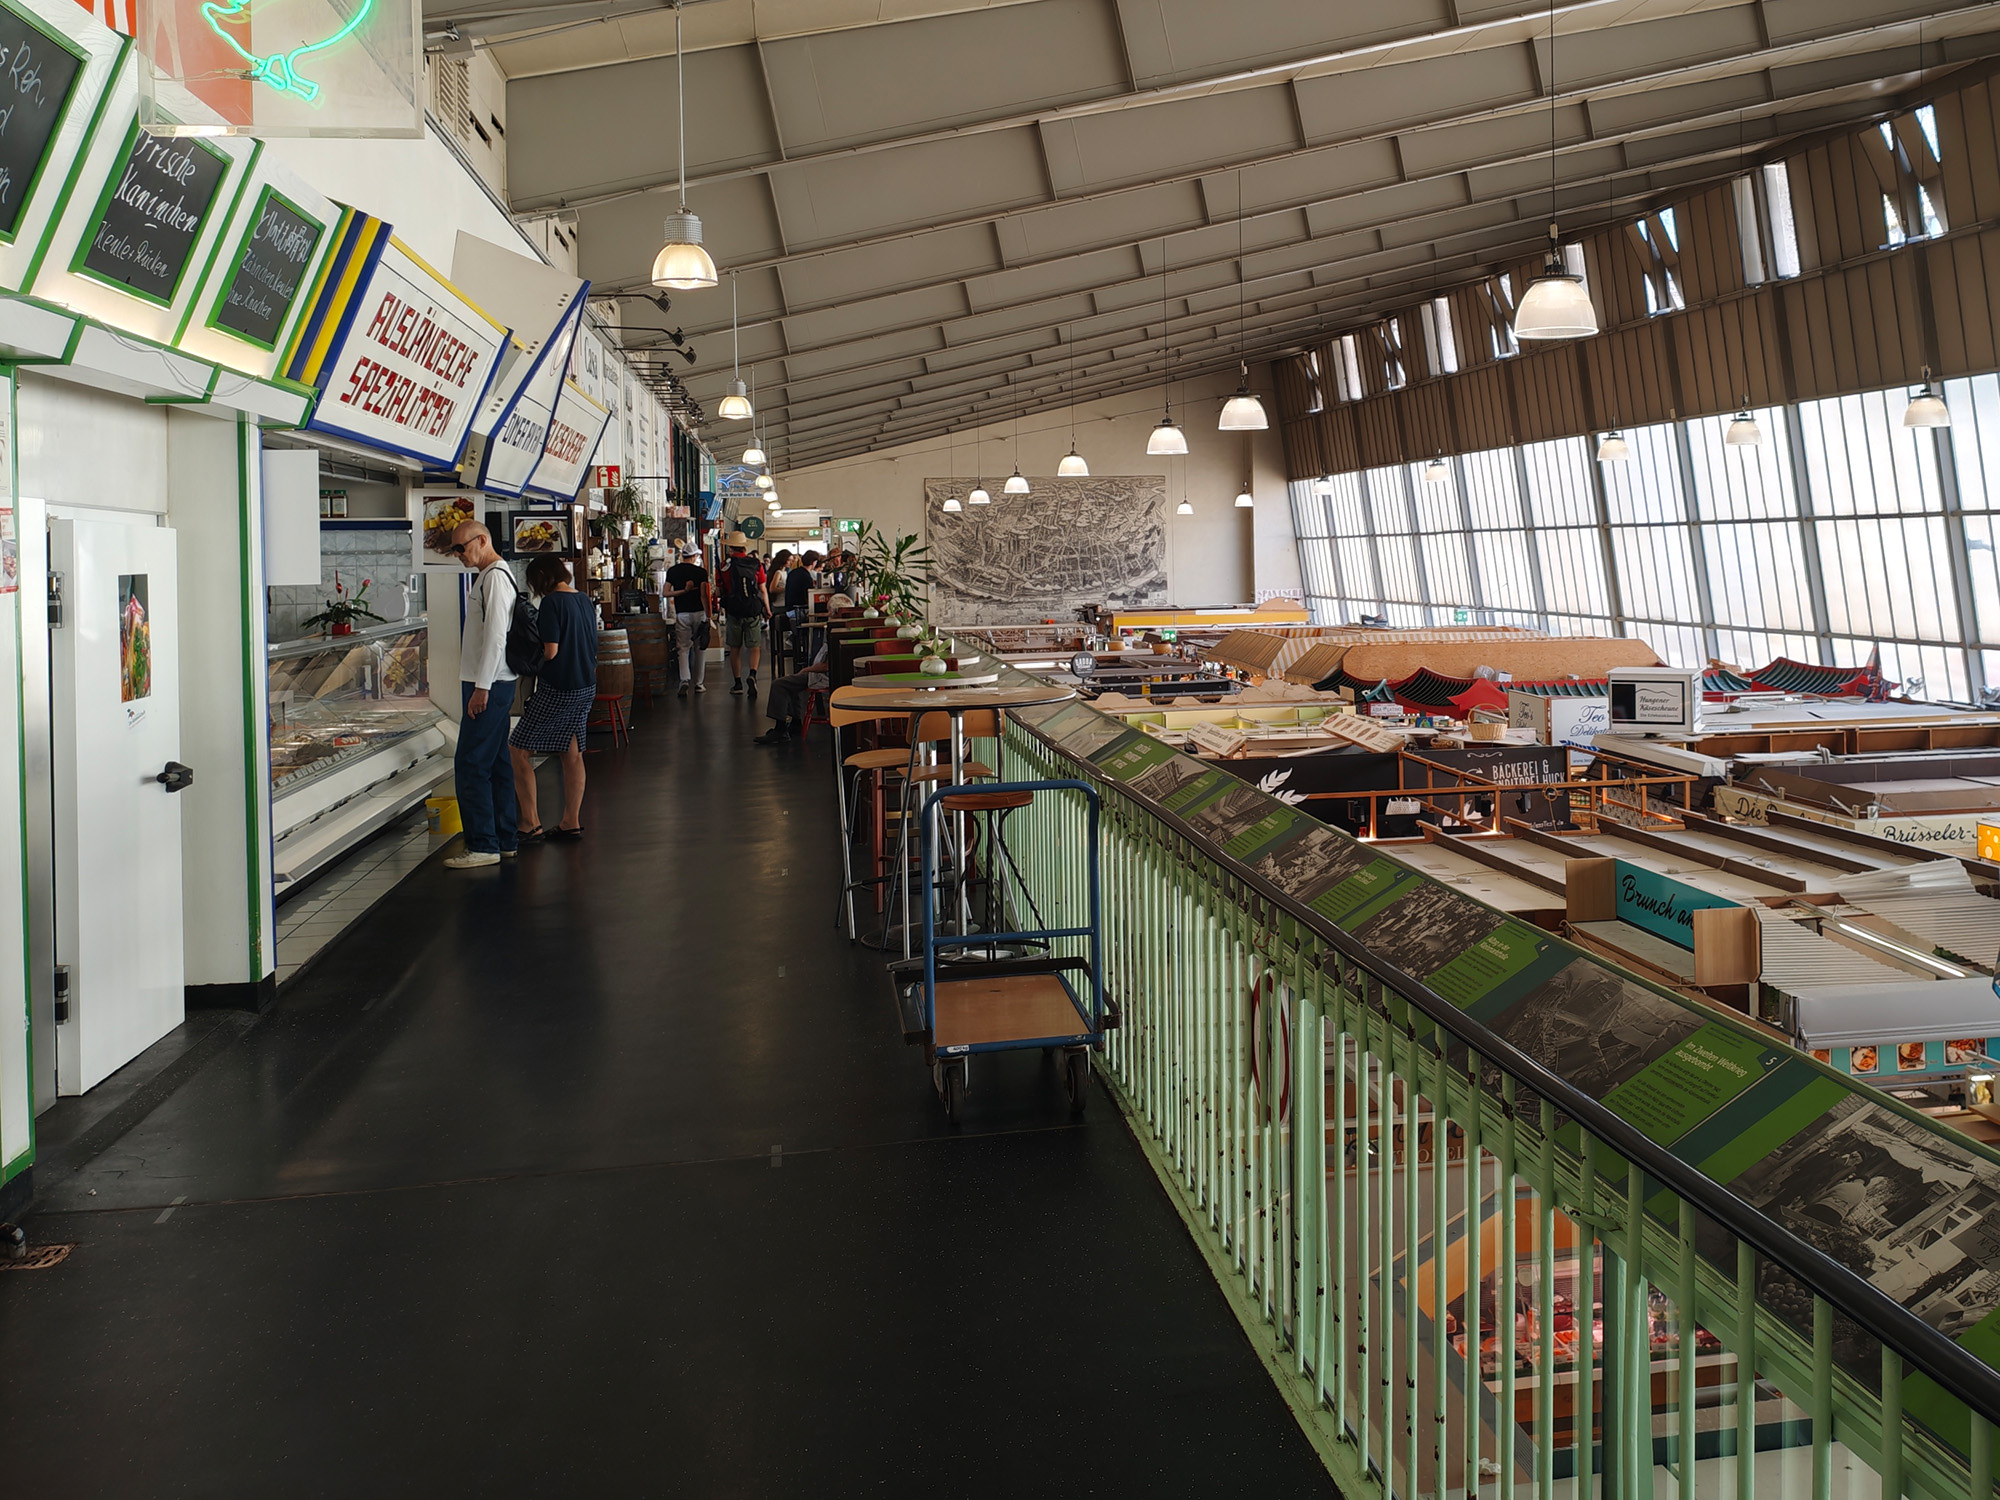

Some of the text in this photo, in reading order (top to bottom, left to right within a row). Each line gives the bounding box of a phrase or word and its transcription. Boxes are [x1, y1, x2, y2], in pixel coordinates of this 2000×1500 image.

[113, 162, 199, 233] Kaninchen
[365, 290, 480, 389] AUSLÄNDISCHE
[339, 354, 459, 440] SPEZIALITÄTEN
[1639, 695, 1671, 704] Hungener
[1639, 704, 1679, 712] Käsescheune
[1492, 759, 1549, 780] BÄCKEREI &
[1735, 797, 1763, 821] Die
[1883, 823, 1978, 843] Brüsseler-
[1622, 874, 1678, 920] Brunch
[1674, 1049, 1714, 1073] ausgebombt
[1684, 1041, 1748, 1079] Im Zweiten Weltkrieg
[1765, 1056, 1777, 1066] 5
